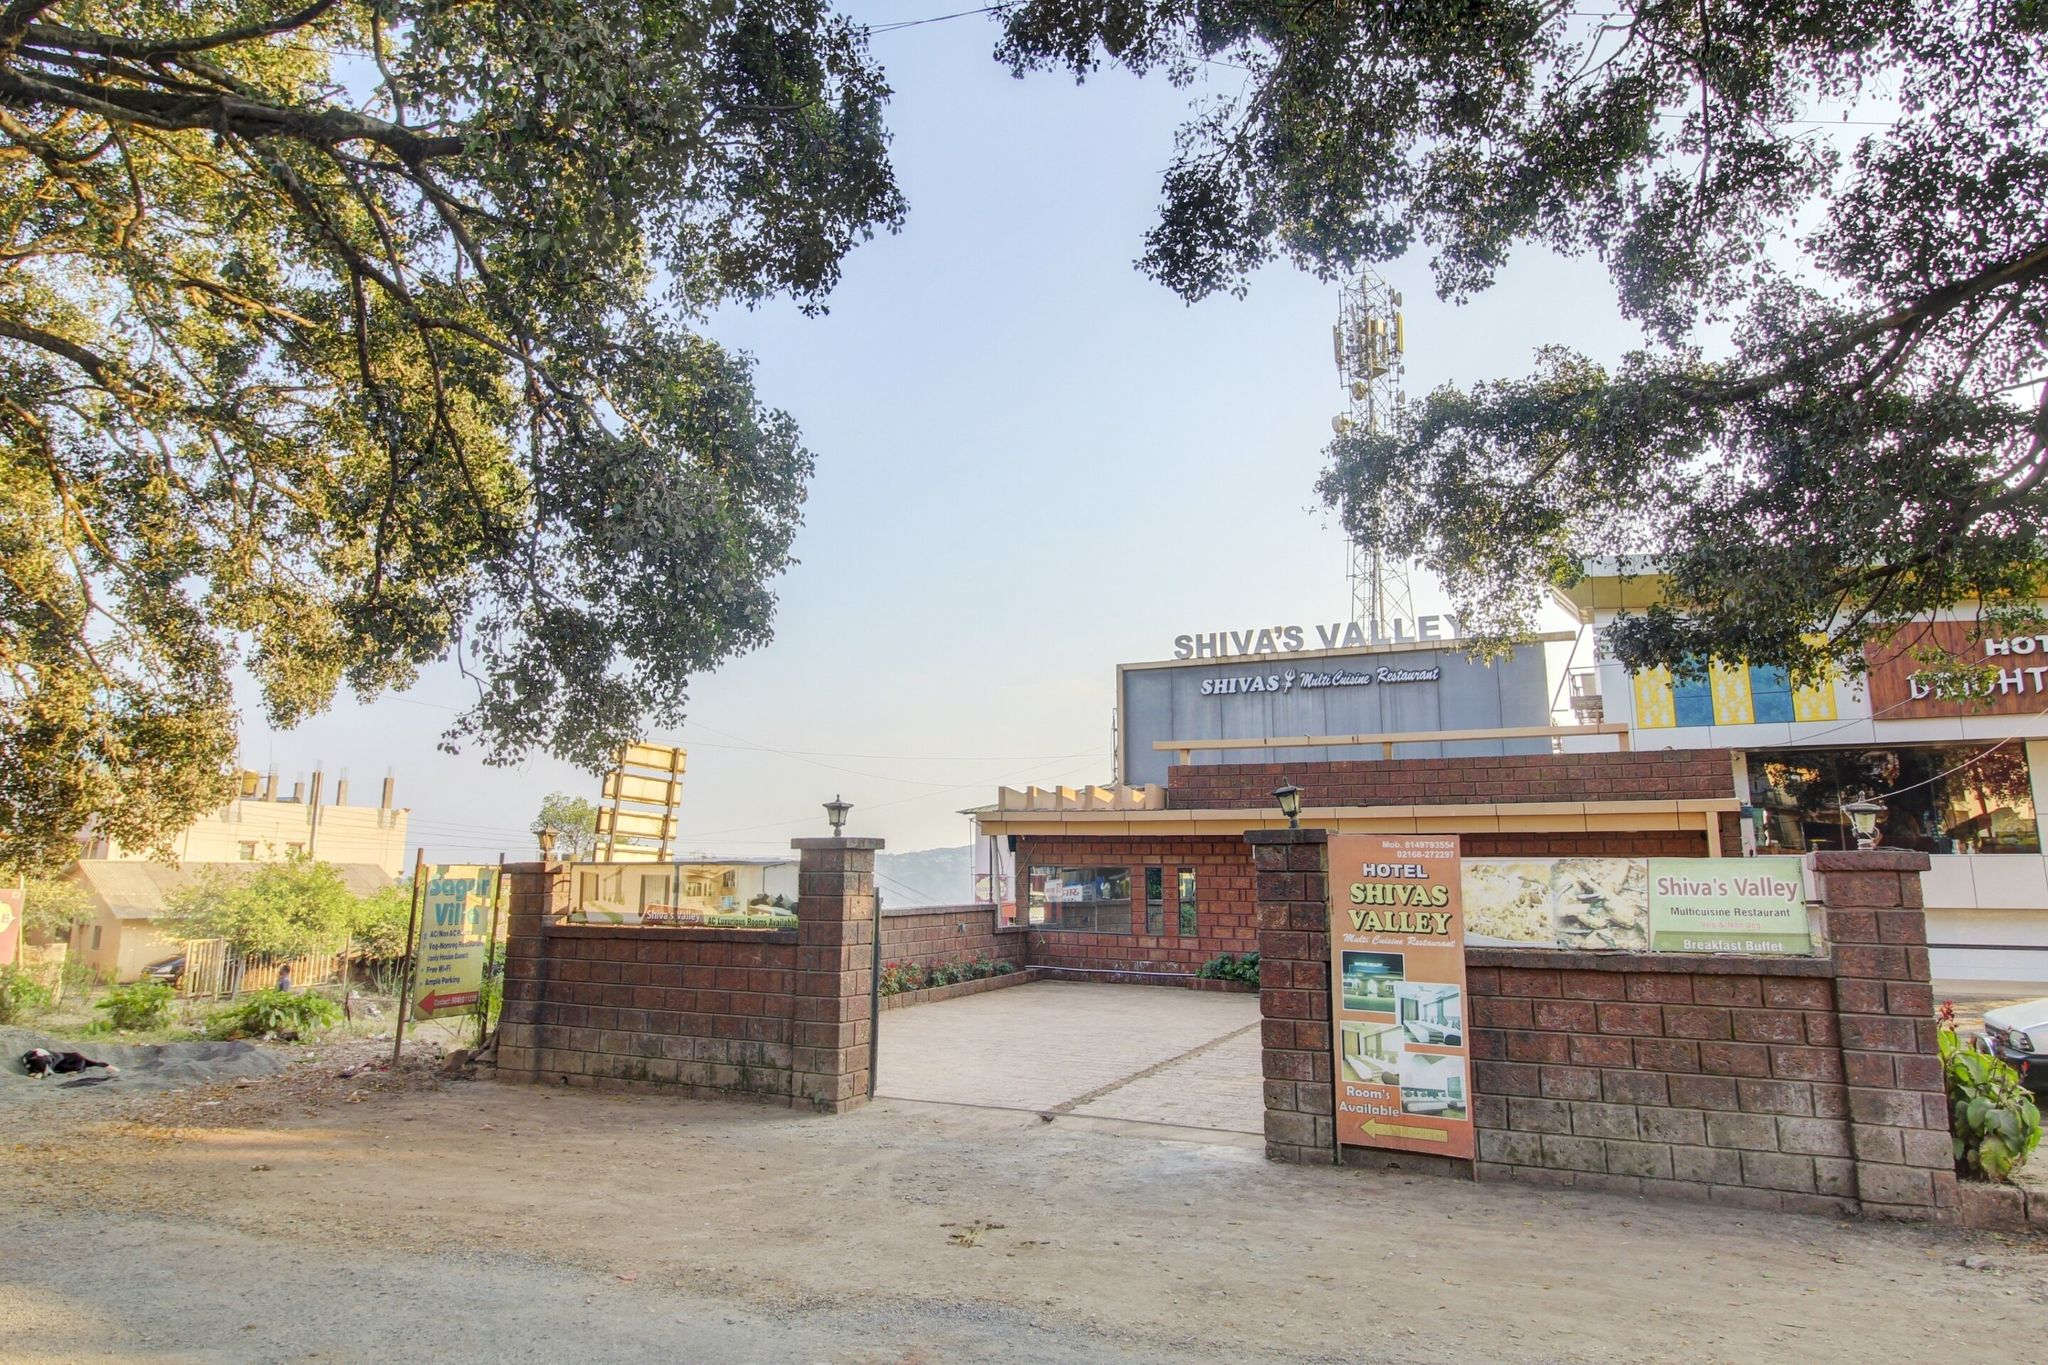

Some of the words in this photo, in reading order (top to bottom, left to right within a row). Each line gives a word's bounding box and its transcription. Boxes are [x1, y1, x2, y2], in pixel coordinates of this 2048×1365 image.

[1174, 625, 1305, 660] SHIVA'S
[1315, 614, 1462, 650] VALLEY
[1201, 675, 1280, 695] SHIVAS
[1300, 672, 1332, 688] Multi
[1332, 670, 1370, 686] Cuisine
[1376, 666, 1440, 684] Restaurant
[1382, 841, 1403, 849] Mob.
[1362, 863, 1430, 879] HOTEL
[1350, 882, 1449, 907] SHIVAS
[1657, 876, 1728, 896] Shiva's
[1733, 876, 1798, 902] Valley
[646, 909, 675, 921] Shiva's
[1670, 906, 1731, 917] Multicuisine
[1734, 907, 1790, 918] Restaurant
[707, 916, 716, 926] AC
[717, 917, 746, 927] Luxurious
[747, 917, 767, 927] Rooms
[768, 918, 798, 928] Available
[1348, 909, 1453, 935] VALLEY
[1343, 933, 1369, 944] Multi
[1371, 935, 1404, 946] Cuisine
[1407, 936, 1456, 948] Restaurant
[1683, 938, 1742, 951] Breakfast
[1745, 939, 1784, 951] Buffet
[1346, 1085, 1391, 1100] Room's
[1338, 1100, 1399, 1118] Available
